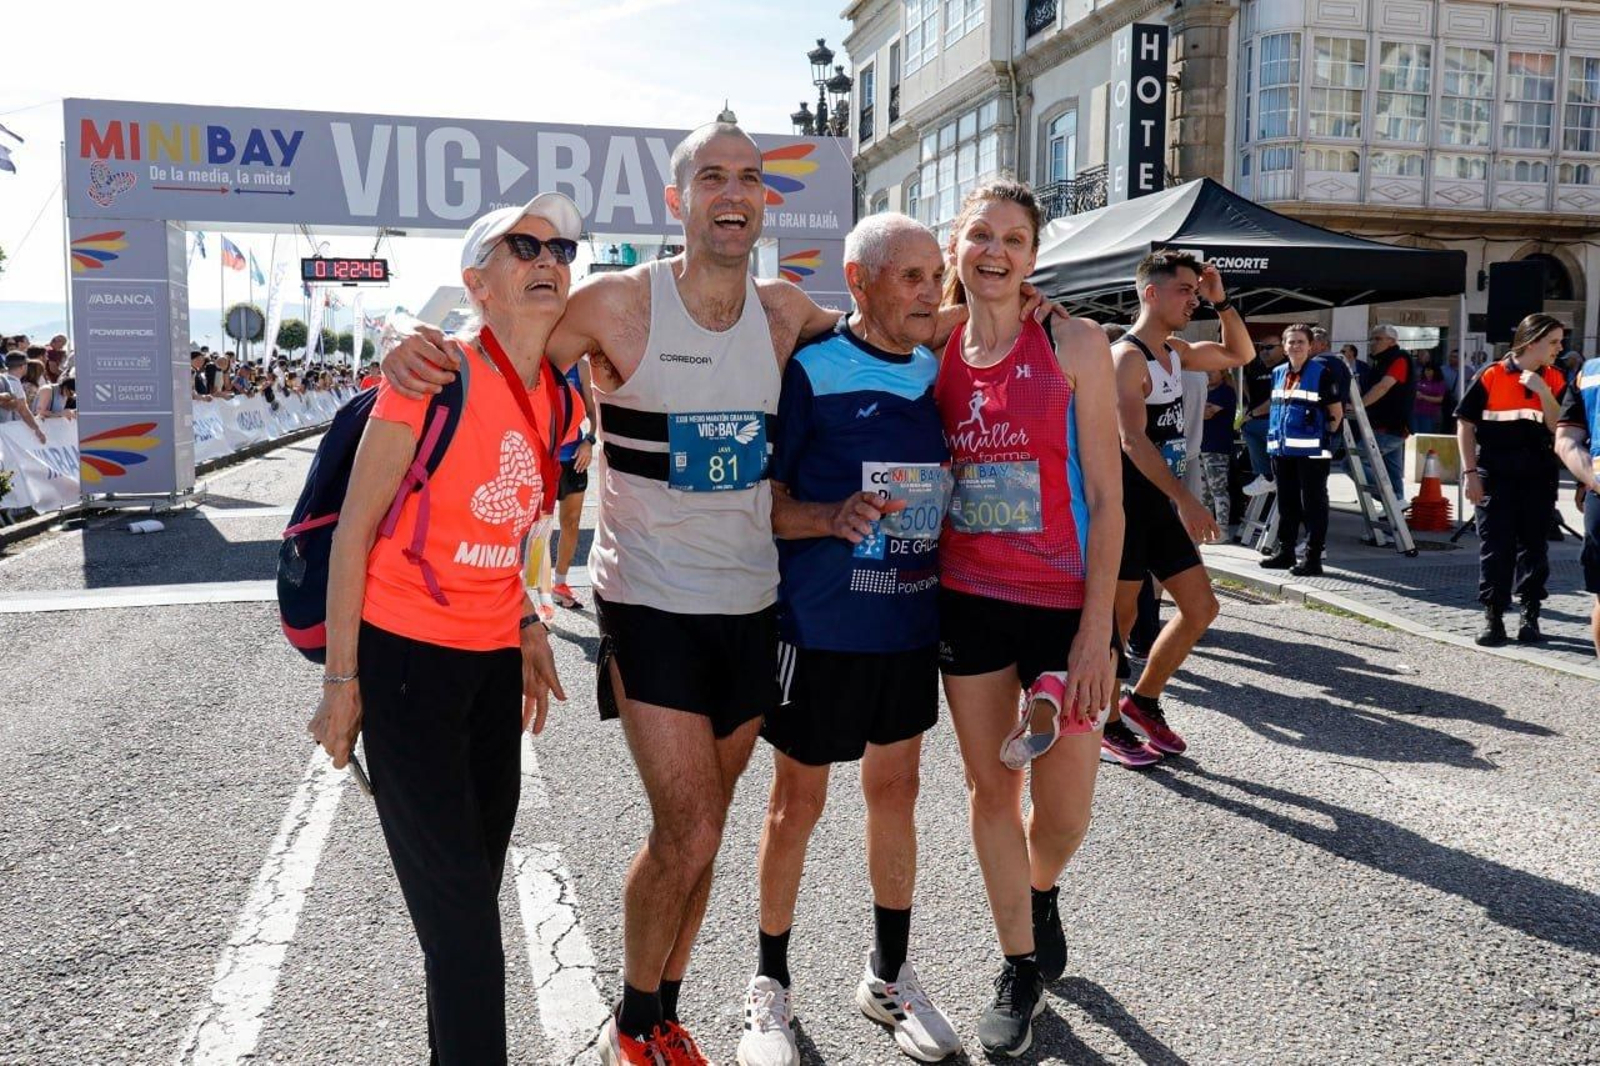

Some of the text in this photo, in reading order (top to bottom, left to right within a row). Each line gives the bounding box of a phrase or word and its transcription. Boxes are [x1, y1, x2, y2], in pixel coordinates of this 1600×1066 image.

[80, 119, 304, 167] MINIBAY
[150, 166, 291, 186] De la media, la mitad
[330, 122, 482, 220] VIG
[780, 213, 806, 228] GRAN
[809, 211, 838, 229] BAHÍA
[698, 422, 739, 437] VIG BAY
[709, 454, 737, 482] 81
[963, 500, 1028, 526] 5004
[890, 539, 910, 554] DE
